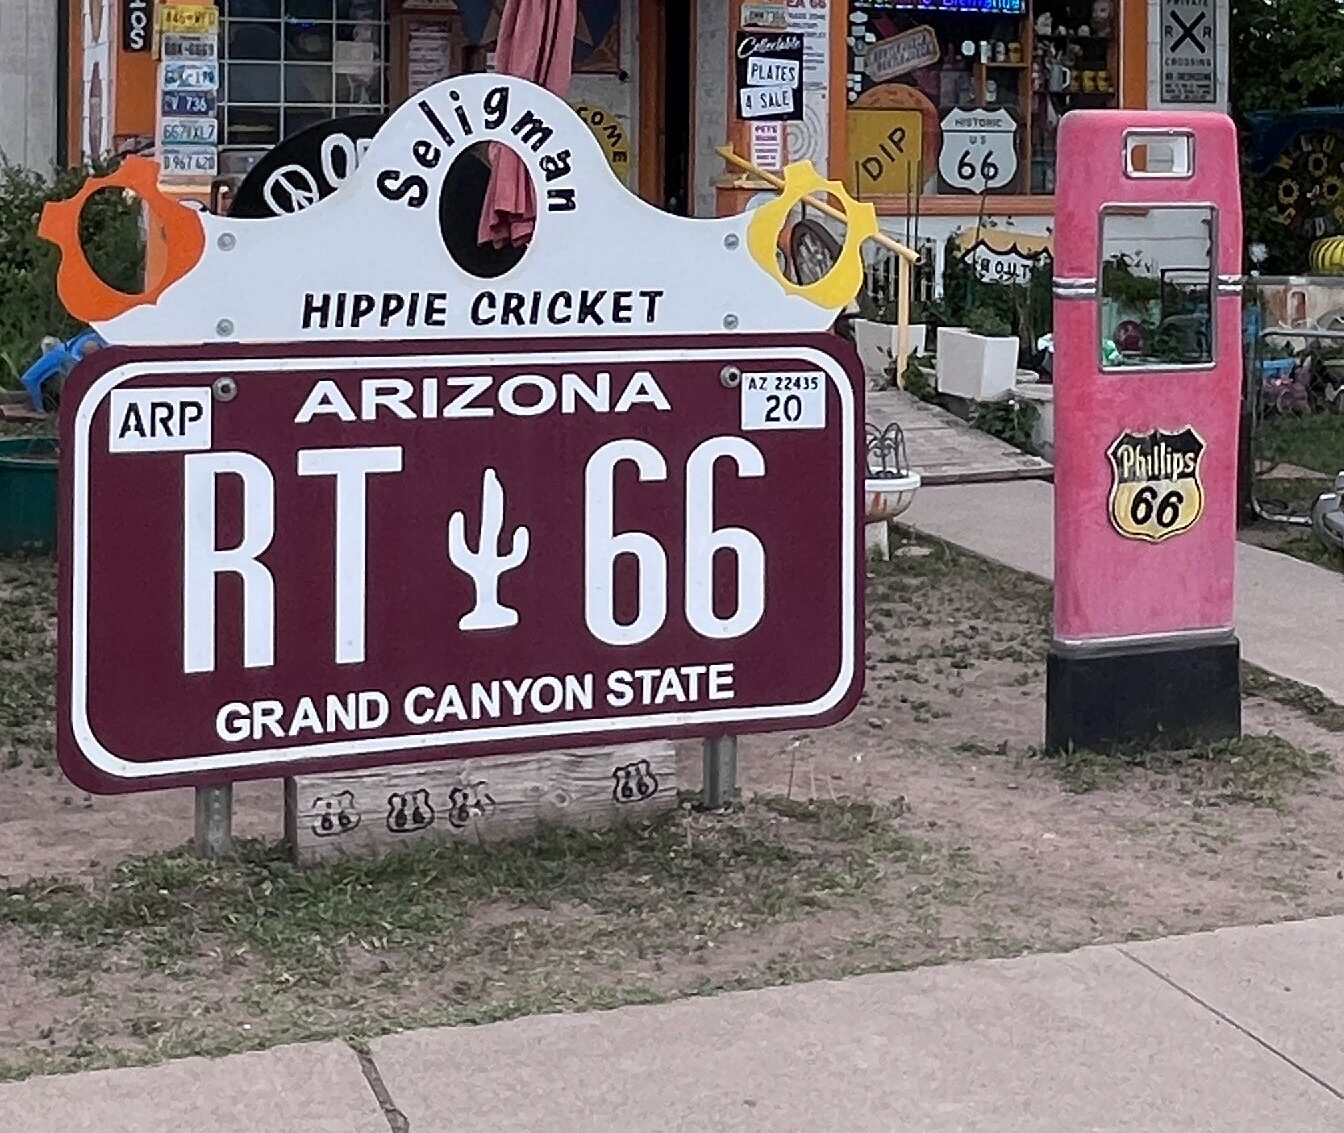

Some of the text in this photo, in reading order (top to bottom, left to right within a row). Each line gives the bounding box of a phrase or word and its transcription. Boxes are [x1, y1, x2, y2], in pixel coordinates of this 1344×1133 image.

[1165, 25, 1212, 39] R R
[751, 63, 795, 82] PLATES
[1165, 58, 1212, 67] CROSSING
[745, 91, 789, 110] 4 SALE
[955, 117, 1003, 128] HISTORIC
[376, 86, 577, 210] Seligman
[861, 127, 906, 182] DIP
[958, 149, 999, 181] 66
[302, 289, 664, 330] HIPPIE CRICKET
[294, 371, 672, 424] ARIZONA
[748, 375, 820, 393] AZ 22435
[117, 399, 205, 442] ARP
[764, 394, 804, 424] 20
[1119, 444, 1197, 482] Phillips
[1130, 485, 1184, 528] 66
[183, 435, 767, 675] RT 66
[215, 663, 736, 744] GRAND CANYON STATE
